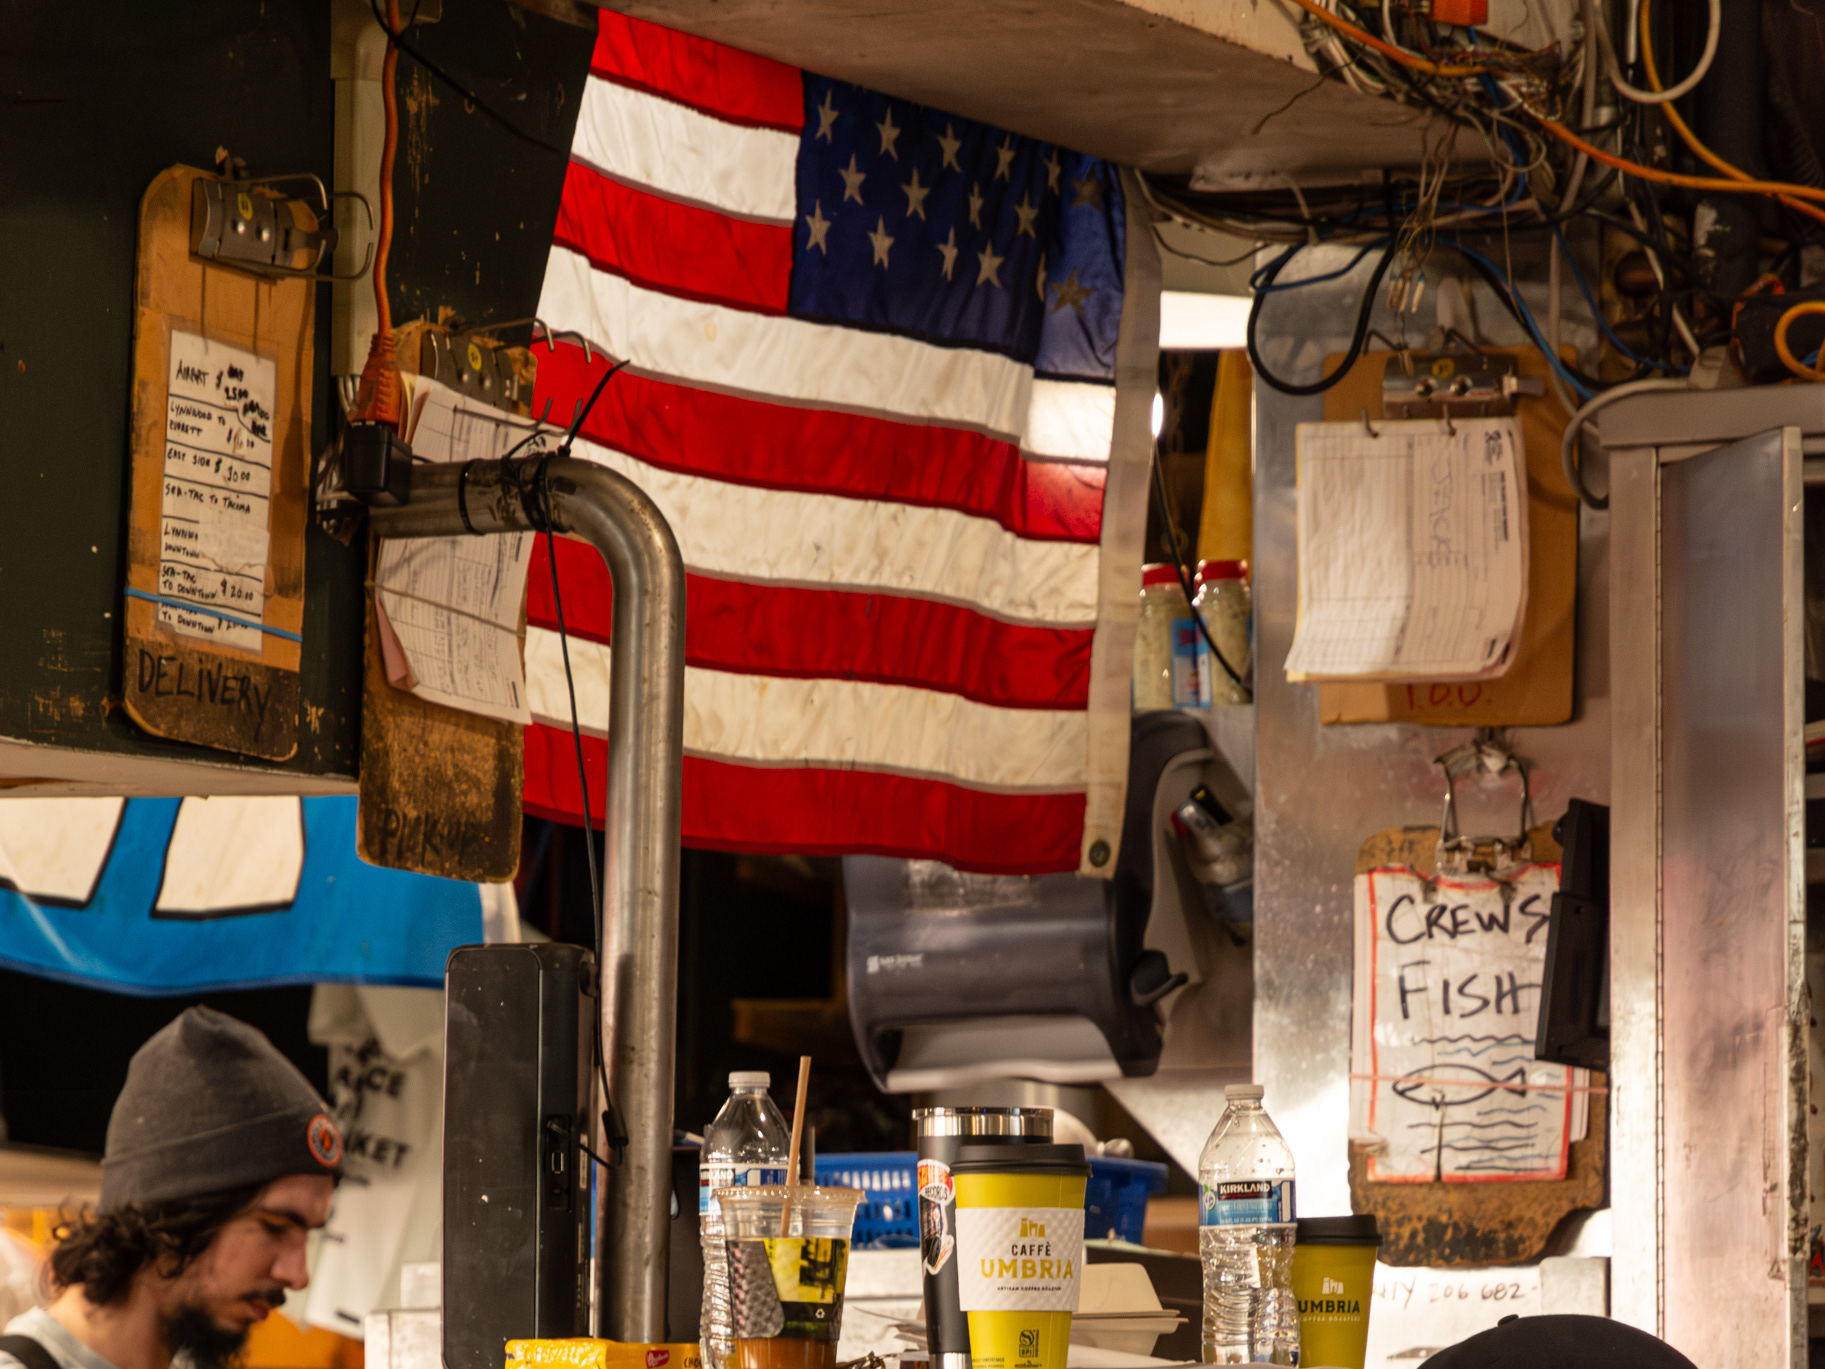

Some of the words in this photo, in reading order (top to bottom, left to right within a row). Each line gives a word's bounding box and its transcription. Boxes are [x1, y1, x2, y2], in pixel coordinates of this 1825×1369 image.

[138, 649, 271, 742] DELIVERY
[1386, 894, 1550, 945] CREWS
[1398, 960, 1546, 1020] FISH
[1219, 1182, 1271, 1195] KIRKLAND
[1011, 1242, 1051, 1257] CAFFÈ
[980, 1258, 1073, 1279] UMBRIA
